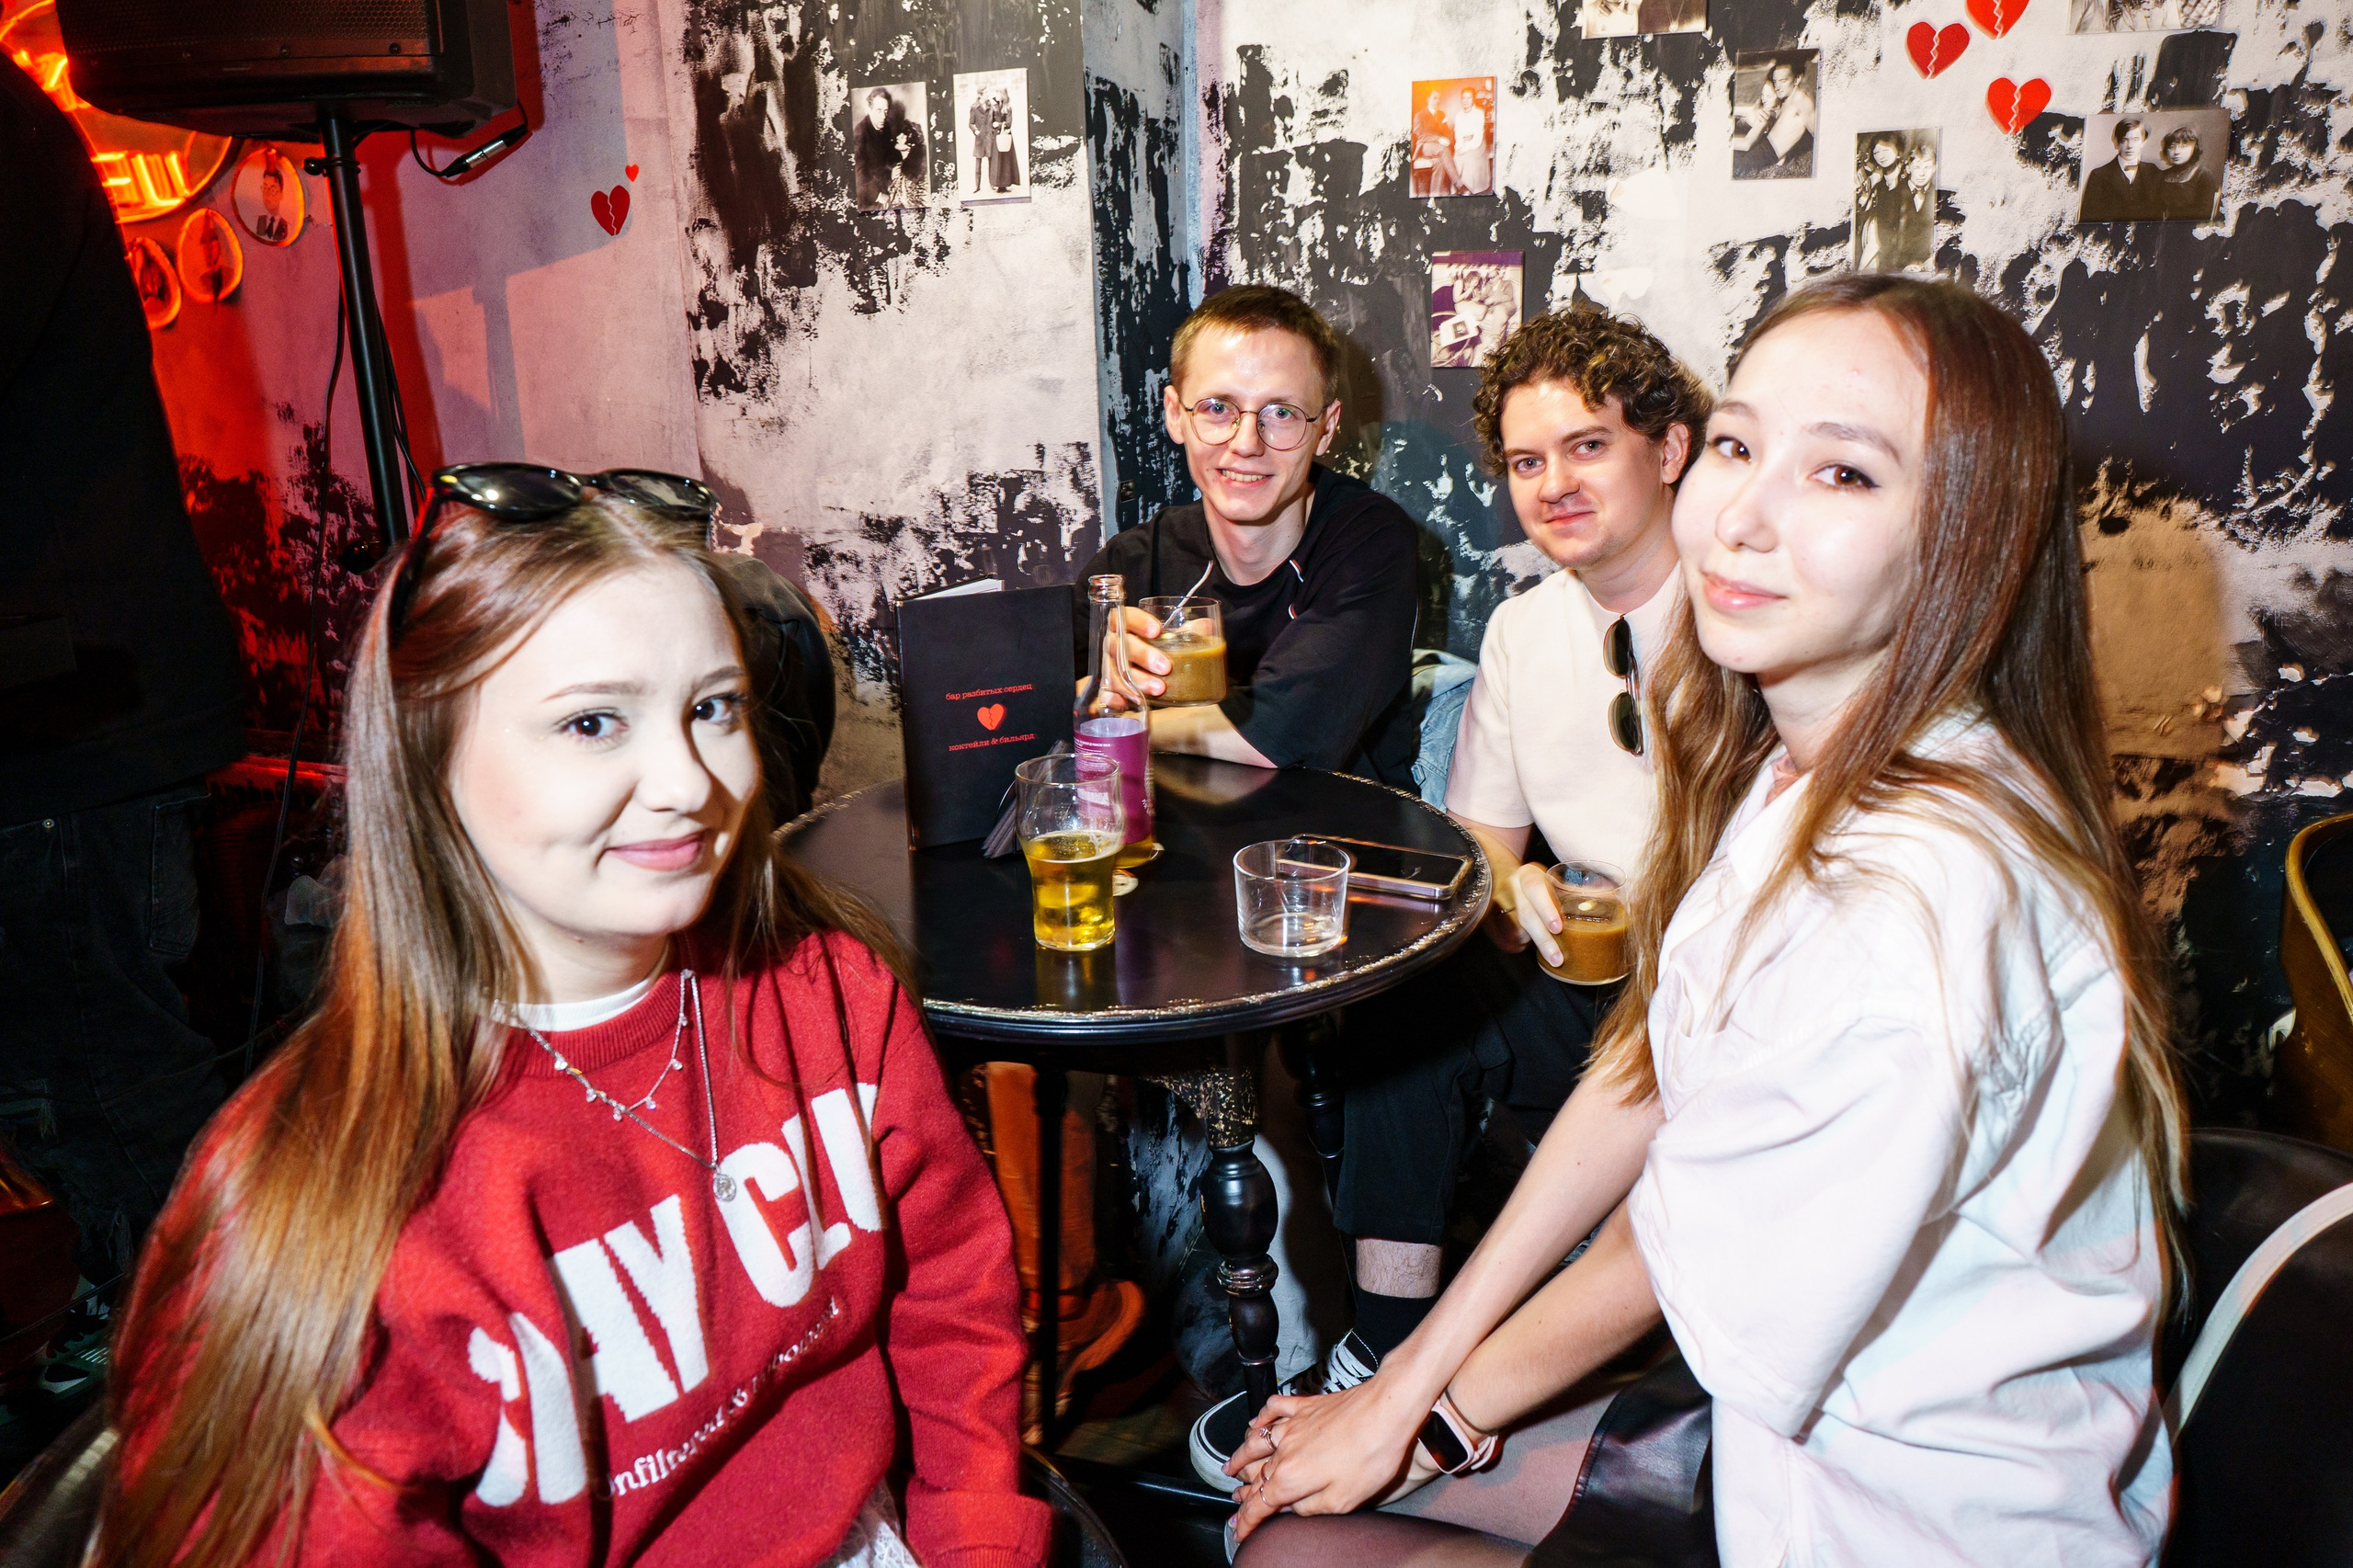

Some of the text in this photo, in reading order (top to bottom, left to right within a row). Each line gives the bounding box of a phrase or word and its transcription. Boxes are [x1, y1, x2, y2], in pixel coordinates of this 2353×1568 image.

[945, 683, 1033, 700] бар разбитых сердец
[949, 740, 990, 752] коктейли
[999, 733, 1036, 744] бильярд
